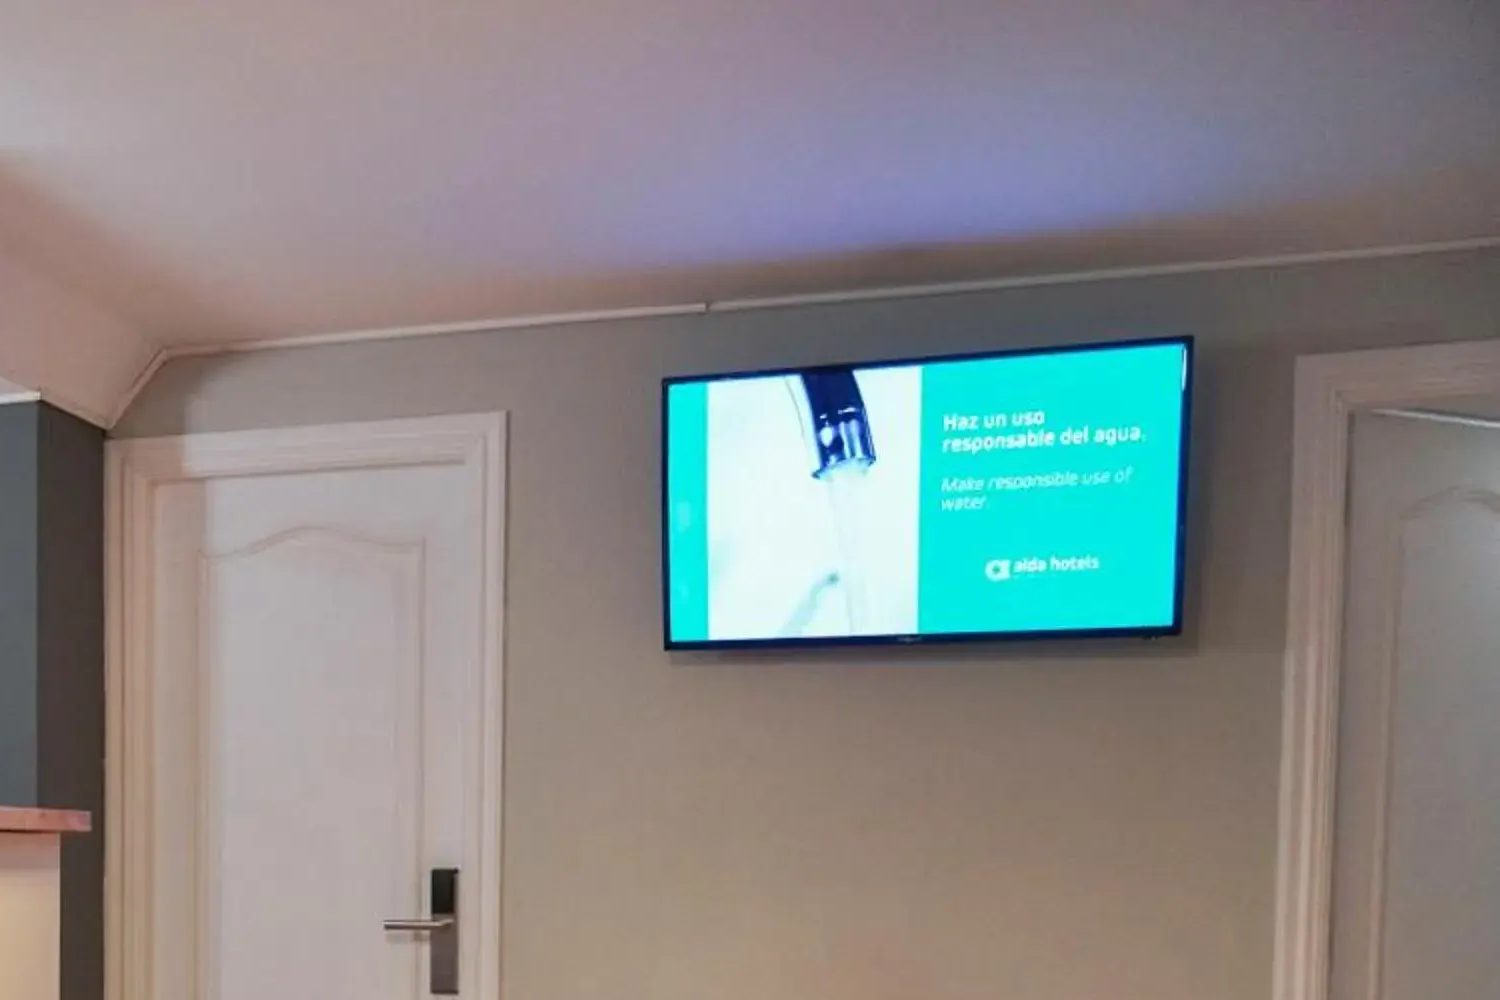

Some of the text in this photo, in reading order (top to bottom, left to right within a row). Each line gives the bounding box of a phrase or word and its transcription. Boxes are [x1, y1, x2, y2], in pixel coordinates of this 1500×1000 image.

[943, 410, 1045, 431] Haz un uso
[942, 425, 1146, 455] responsable del agua.
[941, 464, 1134, 493] Make responsible use of
